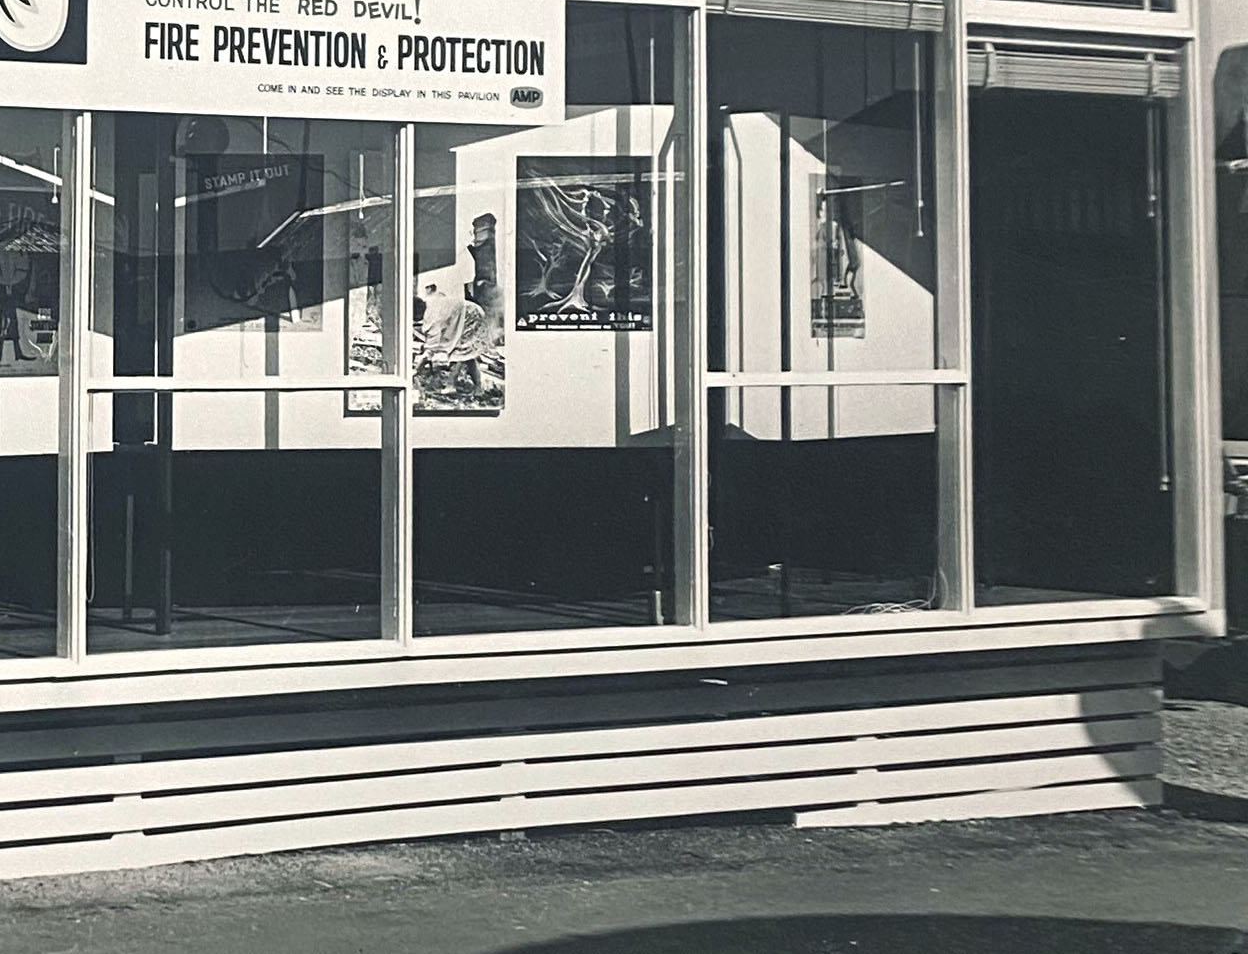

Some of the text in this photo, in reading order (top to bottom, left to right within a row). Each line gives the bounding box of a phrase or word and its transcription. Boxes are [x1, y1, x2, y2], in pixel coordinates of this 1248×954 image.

[144, 21, 545, 76] FIRE PREVENTION & PROTECTION
[257, 83, 500, 102] COME IN AND SEE THE DISPLAY IN THIS PAVILION
[512, 89, 540, 104] AMP
[204, 173, 246, 190] STAMP
[264, 165, 290, 180] OUT
[528, 311, 643, 324] prevent this
